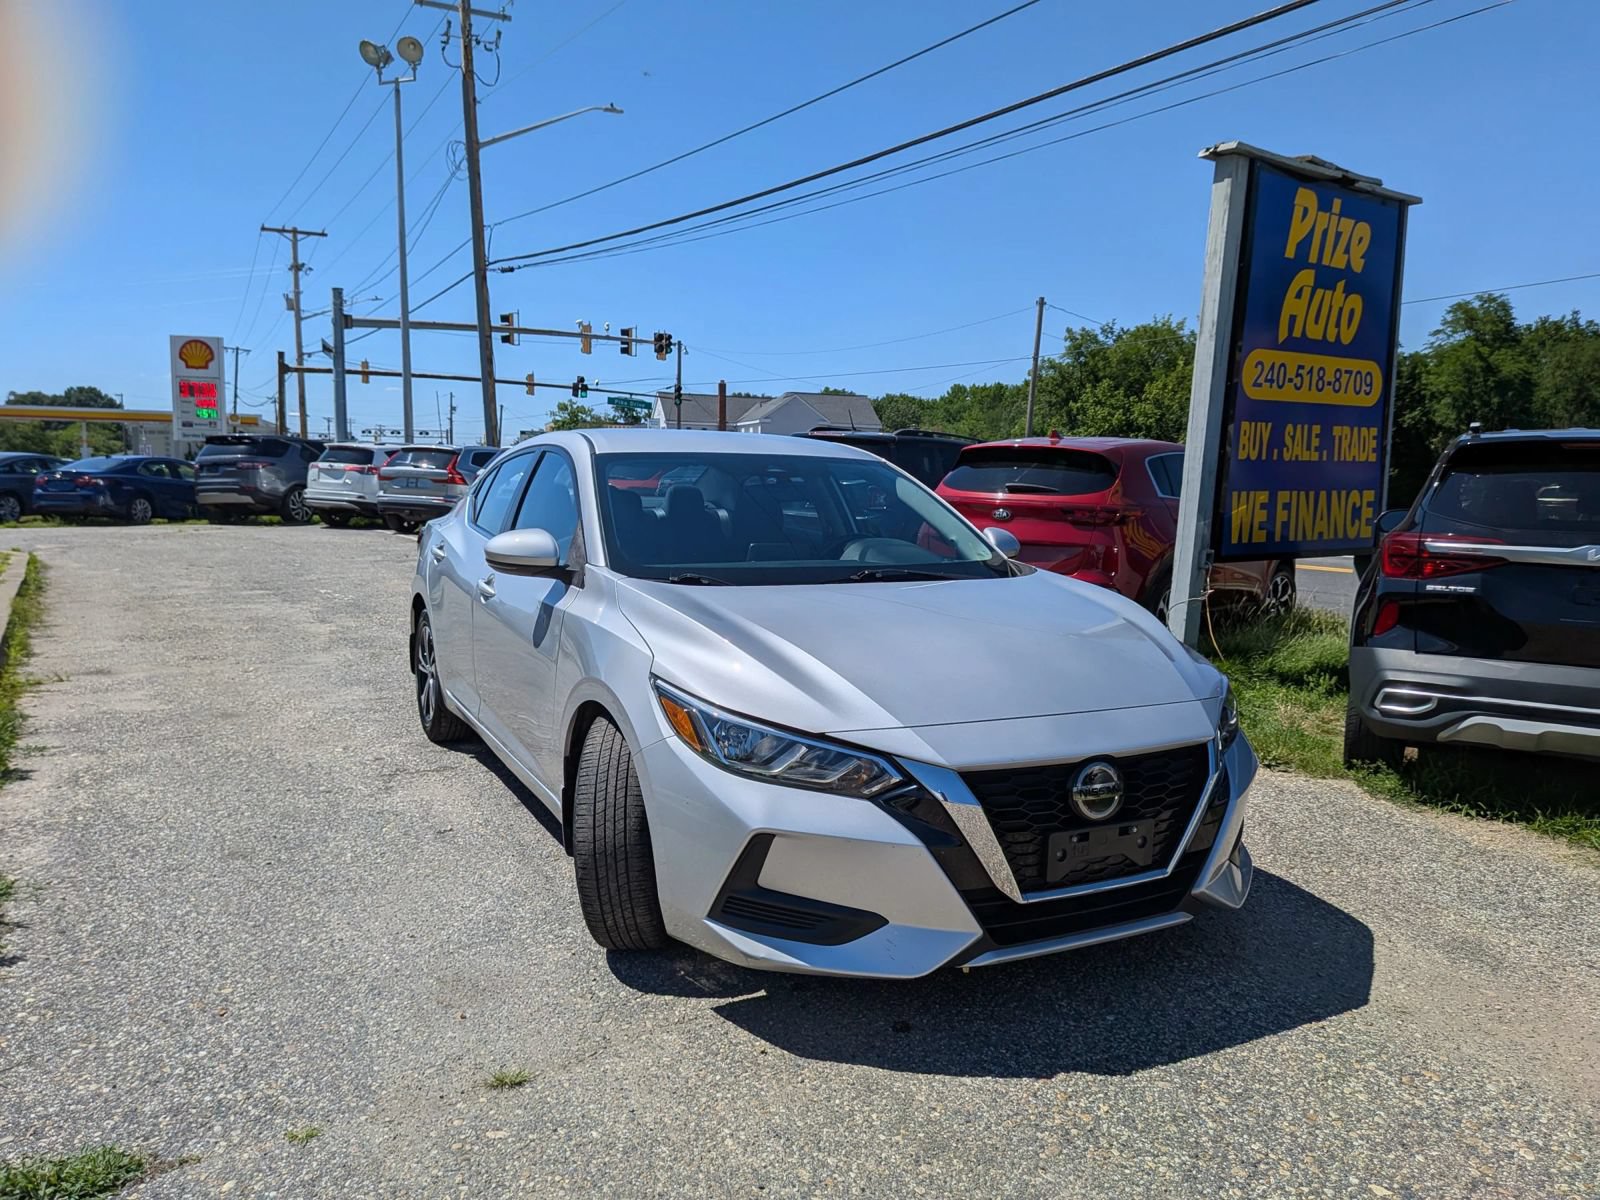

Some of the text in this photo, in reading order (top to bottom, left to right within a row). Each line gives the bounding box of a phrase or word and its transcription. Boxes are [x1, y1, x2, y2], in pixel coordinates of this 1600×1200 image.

[1284, 186, 1371, 273] Prize
[1278, 268, 1364, 345] Auto
[1251, 360, 1374, 396] 240-518-8709
[1238, 421, 1272, 461] BUY
[1283, 423, 1321, 462] SALE
[1332, 425, 1378, 463] TRADE
[1231, 489, 1376, 544] WE FINANCE
[1079, 782, 1119, 798] NISSAN
